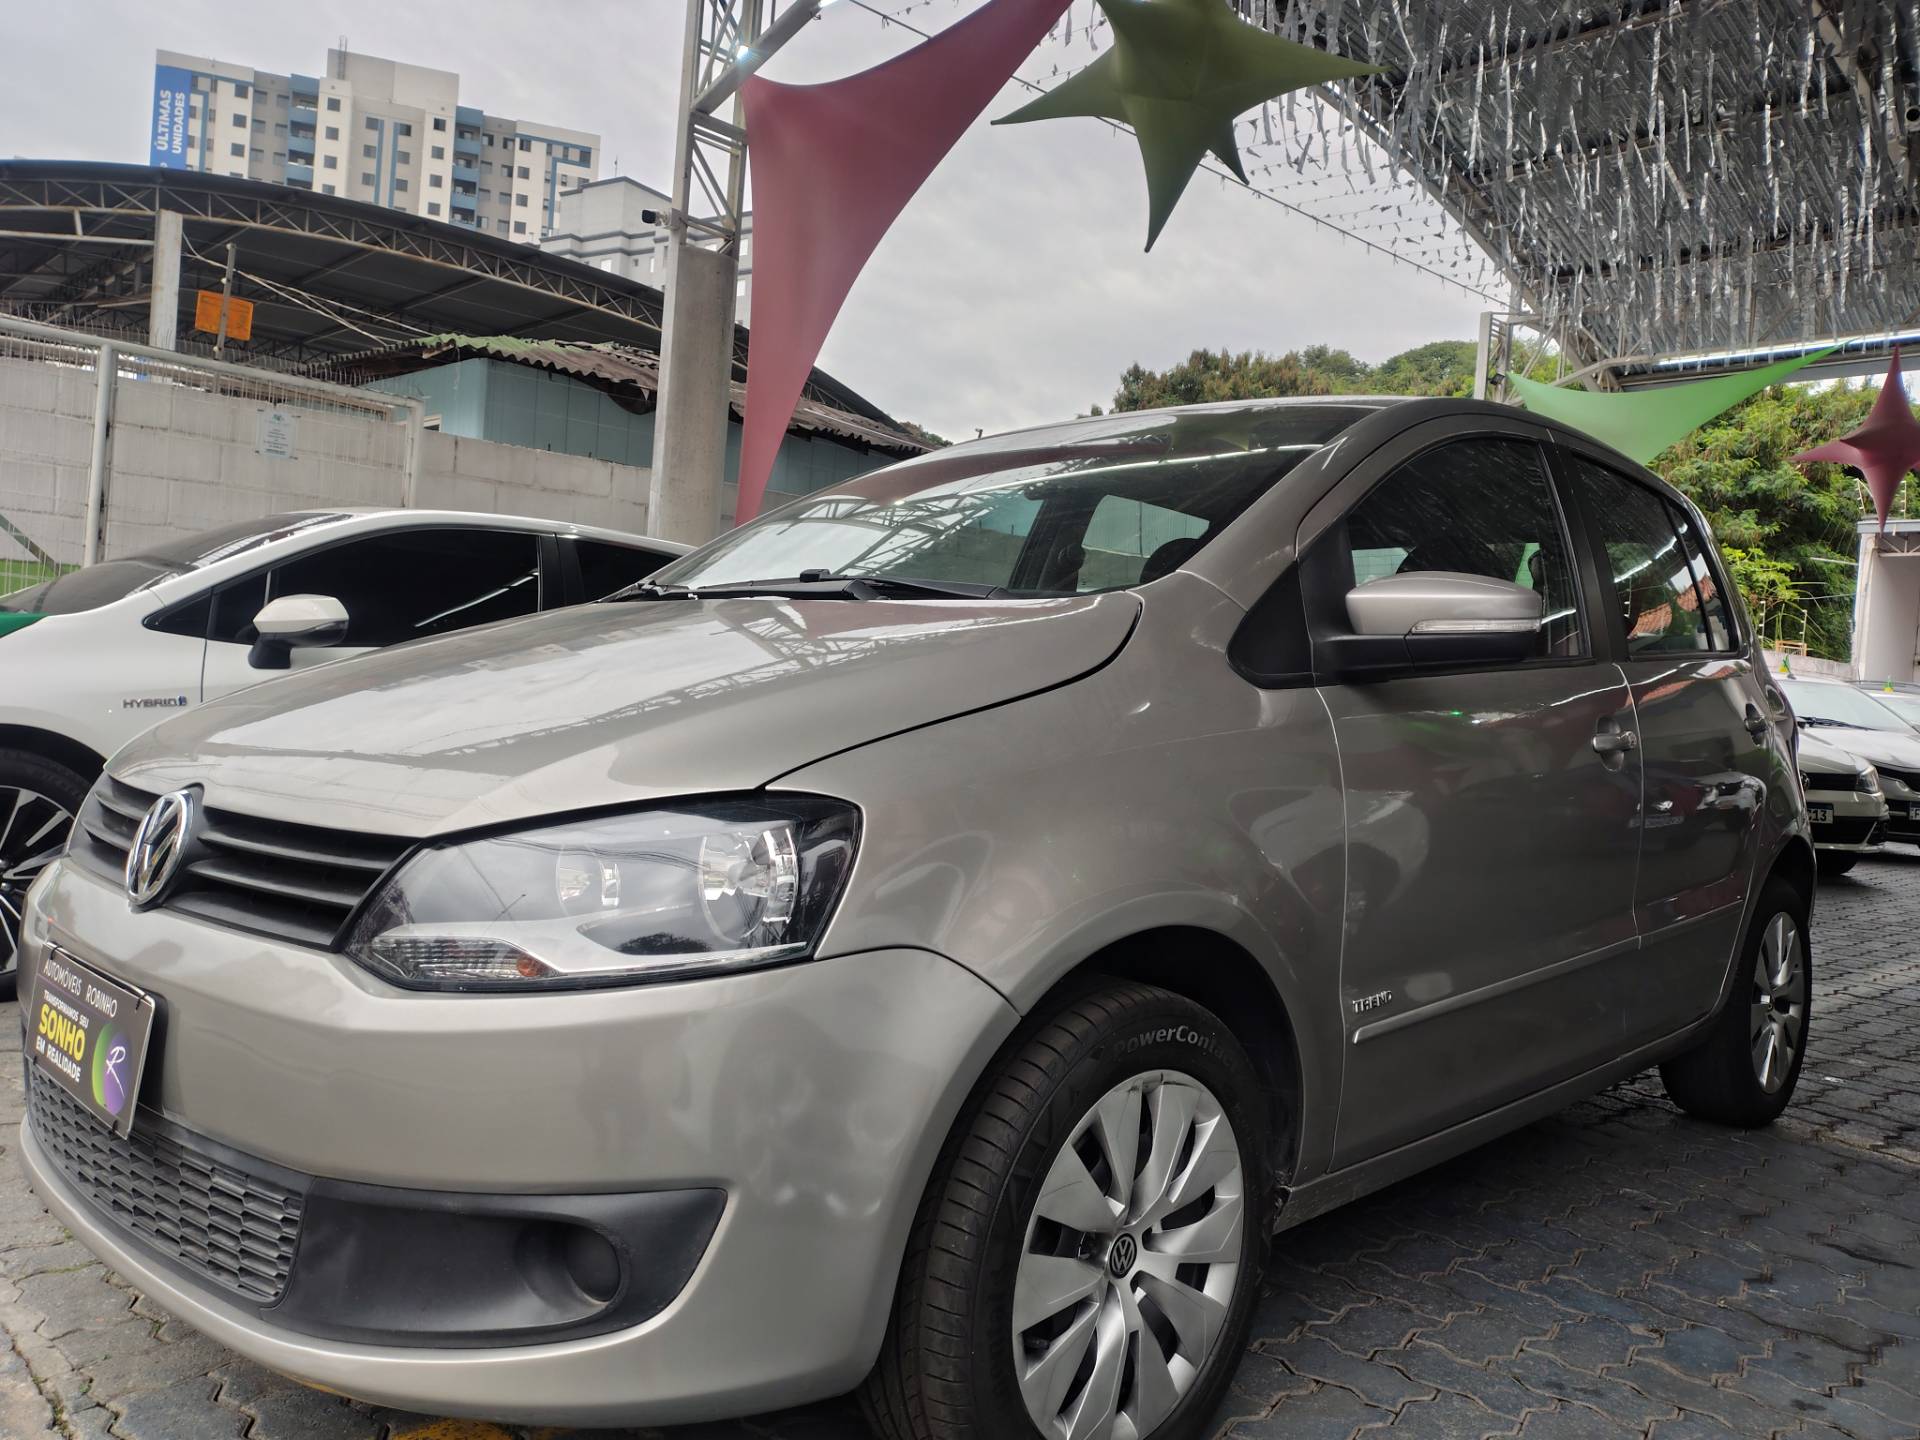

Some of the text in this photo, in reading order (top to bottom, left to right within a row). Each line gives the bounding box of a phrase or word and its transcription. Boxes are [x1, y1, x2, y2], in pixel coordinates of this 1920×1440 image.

[154, 89, 171, 151] ÚLTIMAS
[171, 92, 186, 154] UNIDADES
[122, 698, 178, 708] HYBRID
[43, 958, 118, 1018] AUTOMÓVEIS ROBINHO
[1352, 990, 1392, 1013] TREND
[38, 1003, 86, 1062] SONHO
[79, 1008, 90, 1029] SEU
[35, 1035, 82, 1083] EM REALIDADE
